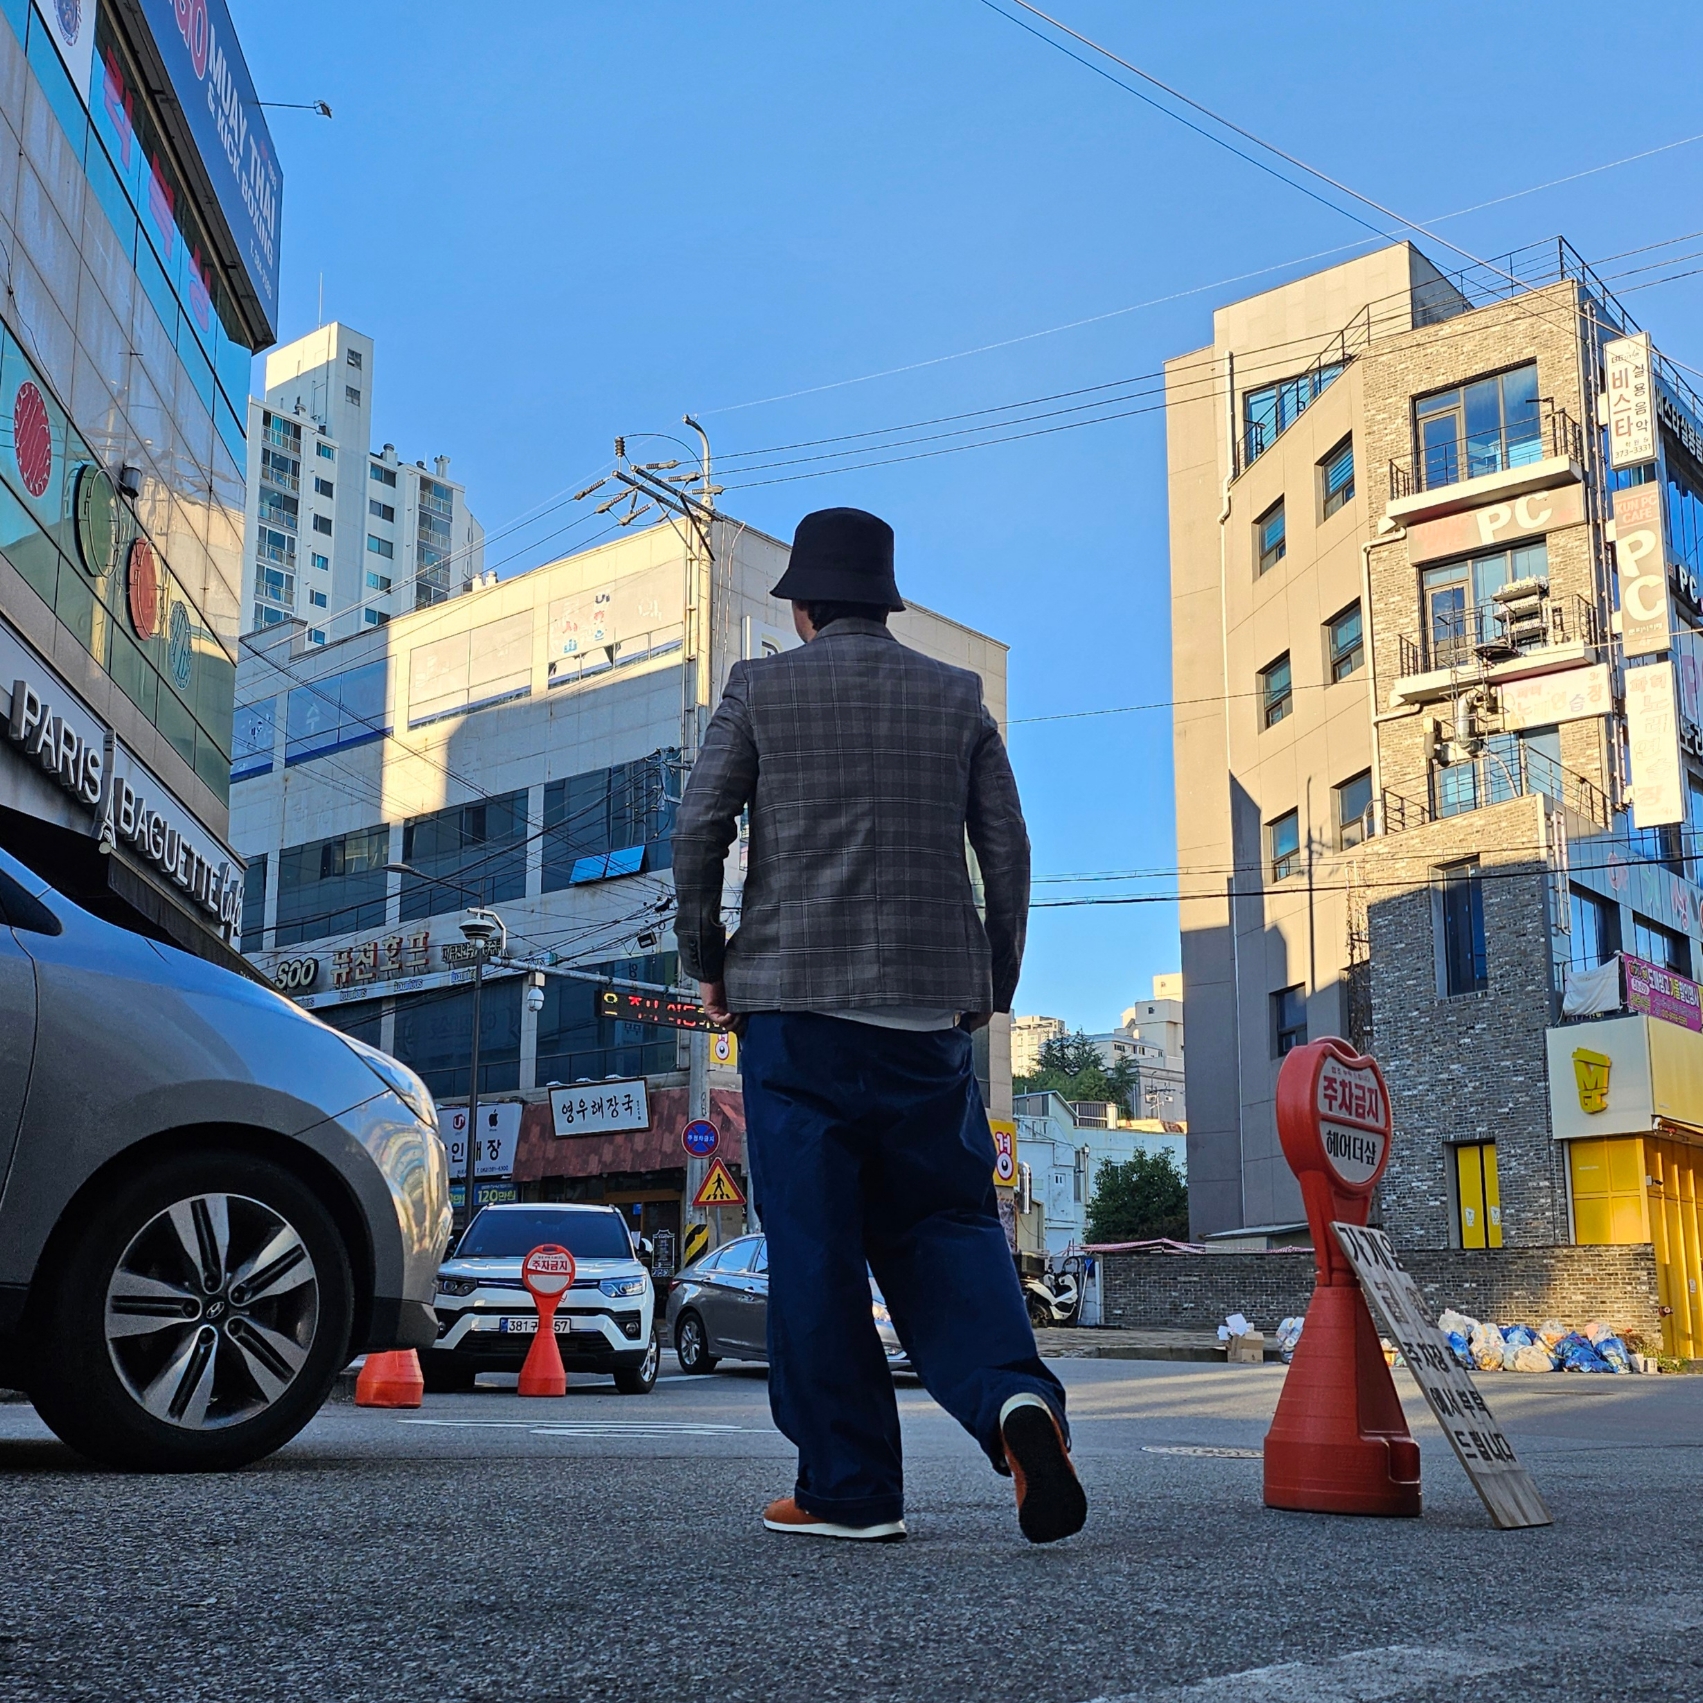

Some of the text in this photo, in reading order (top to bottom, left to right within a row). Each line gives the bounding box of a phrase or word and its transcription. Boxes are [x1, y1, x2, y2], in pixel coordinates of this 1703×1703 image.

[209, 23, 275, 240] MUAY THAI
[217, 105, 240, 184] KICK
[241, 170, 274, 269] BOXING
[1611, 367, 1634, 438] 비스타
[1632, 363, 1649, 432] 실용음악
[1615, 443, 1652, 459] 373-3331
[1476, 490, 1553, 546] PC
[1616, 494, 1658, 515] KUN PC
[1622, 508, 1653, 523] CAFE
[1617, 529, 1667, 622] PC
[10, 680, 101, 804] PARIS
[115, 778, 220, 912] BAGUETTE
[276, 958, 318, 989] SOO
[330, 931, 430, 987] 퓨전호프
[561, 1093, 634, 1124] 영우해장국
[1323, 1075, 1379, 1123] 주차금지
[1326, 1130, 1377, 1166] 헤어더샵
[509, 1320, 568, 1332] 381구57
